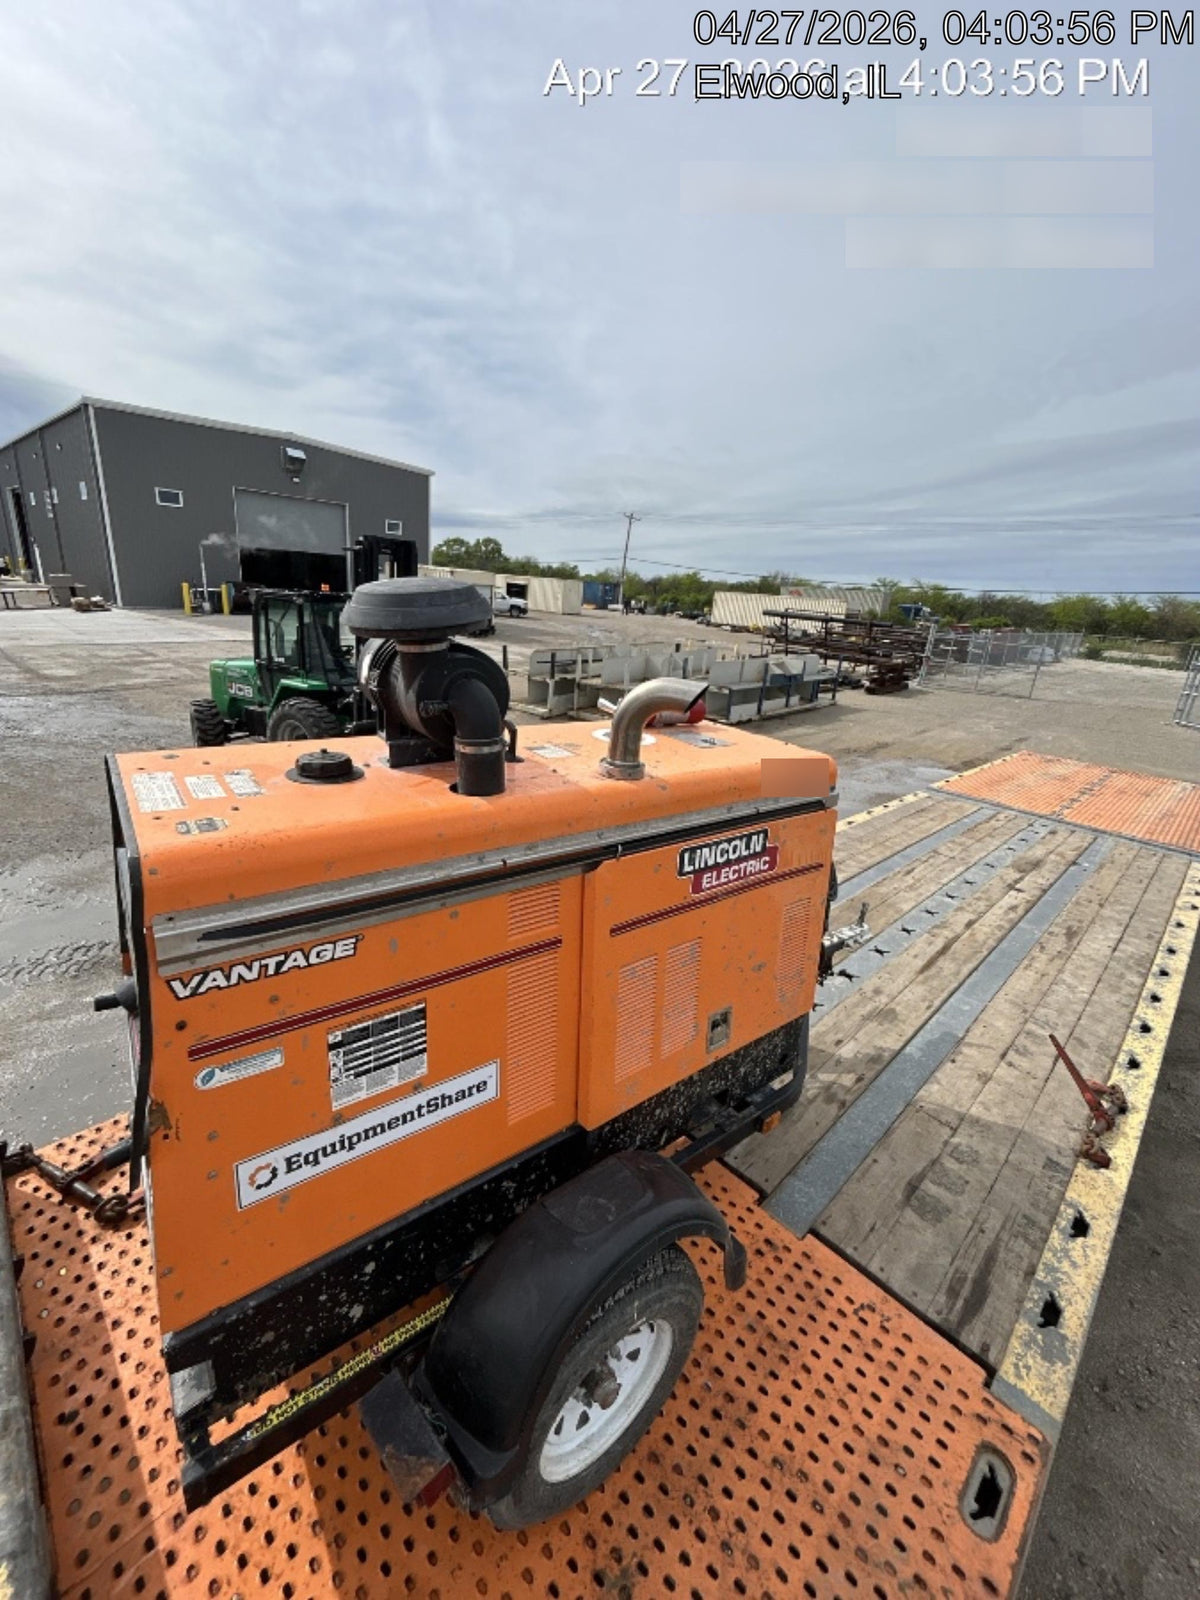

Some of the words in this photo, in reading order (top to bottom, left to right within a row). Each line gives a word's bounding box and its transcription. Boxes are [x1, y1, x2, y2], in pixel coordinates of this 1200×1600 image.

[228, 682, 253, 698] JCB
[683, 833, 764, 873] LINCOLN
[702, 856, 771, 889] ELECTRIC
[168, 937, 358, 999] VANTAGE
[284, 1079, 488, 1175] EquipmentShare
